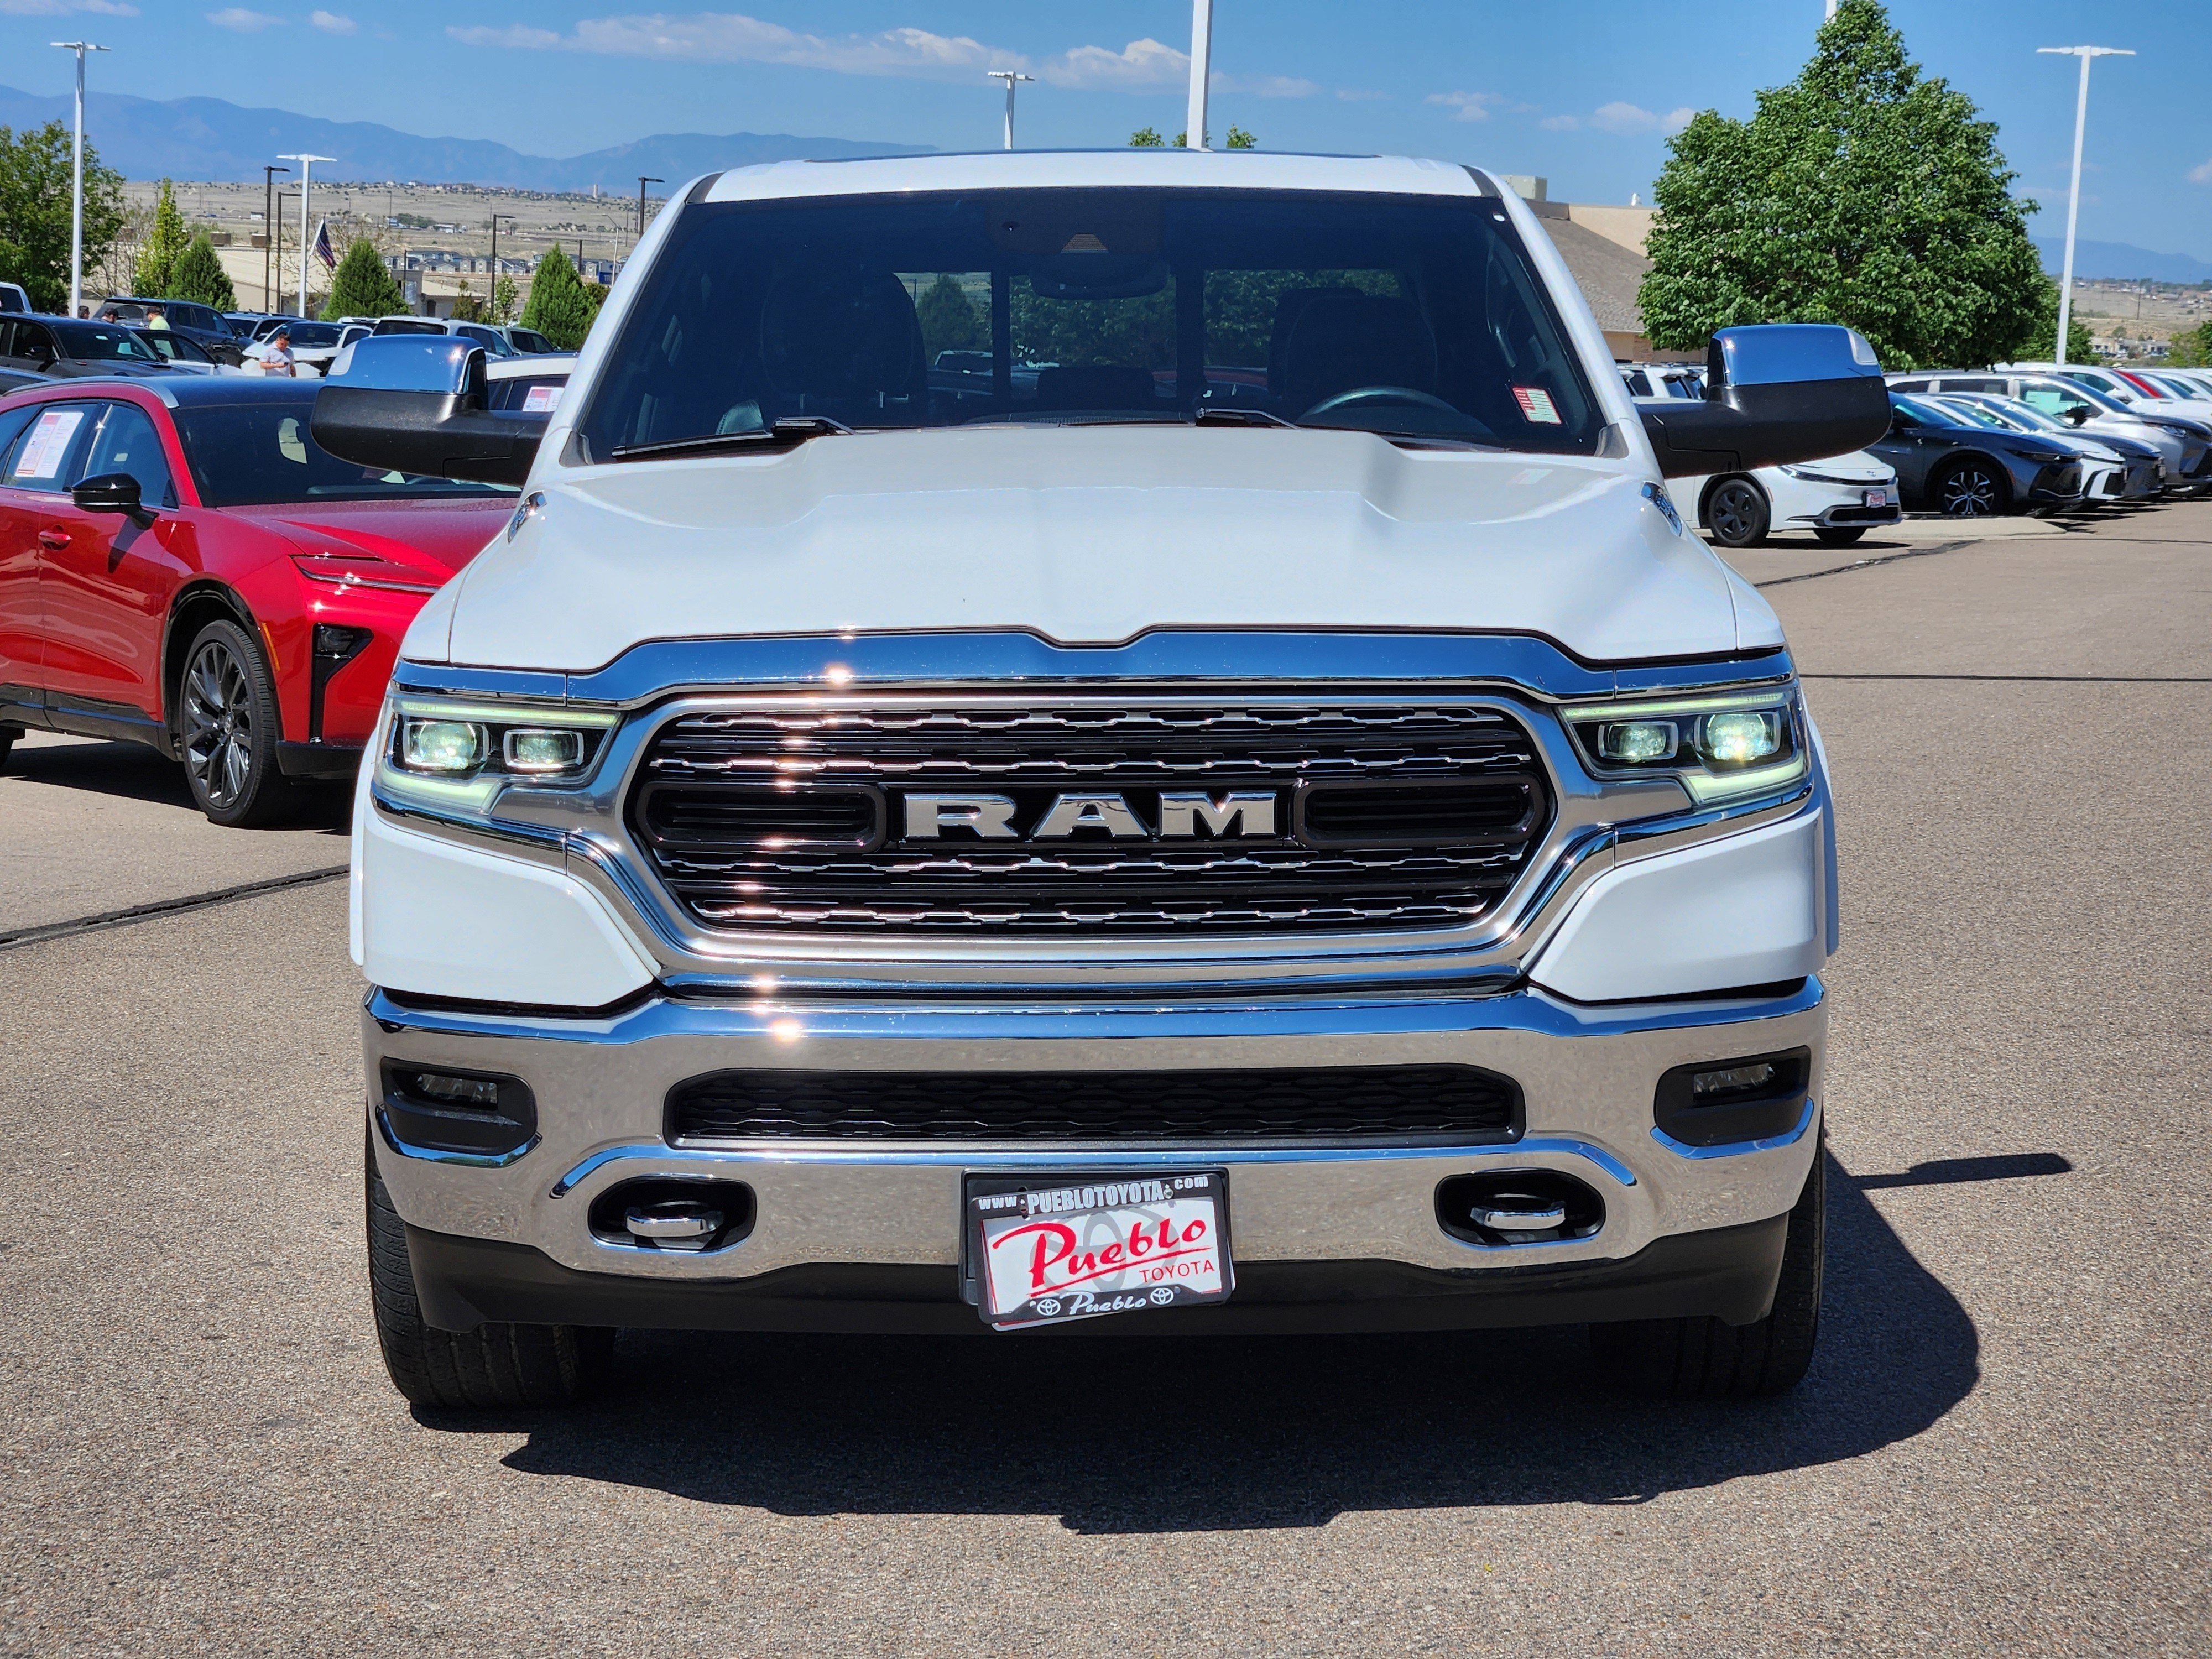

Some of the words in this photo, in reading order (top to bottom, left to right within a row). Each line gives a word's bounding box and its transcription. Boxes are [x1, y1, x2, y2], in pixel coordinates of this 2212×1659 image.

[904, 792, 1276, 837] RAM
[992, 1218, 1207, 1289] Pueblo
[1139, 1260, 1215, 1284] TOYOTA
[1060, 1291, 1147, 1316] Pueblo
